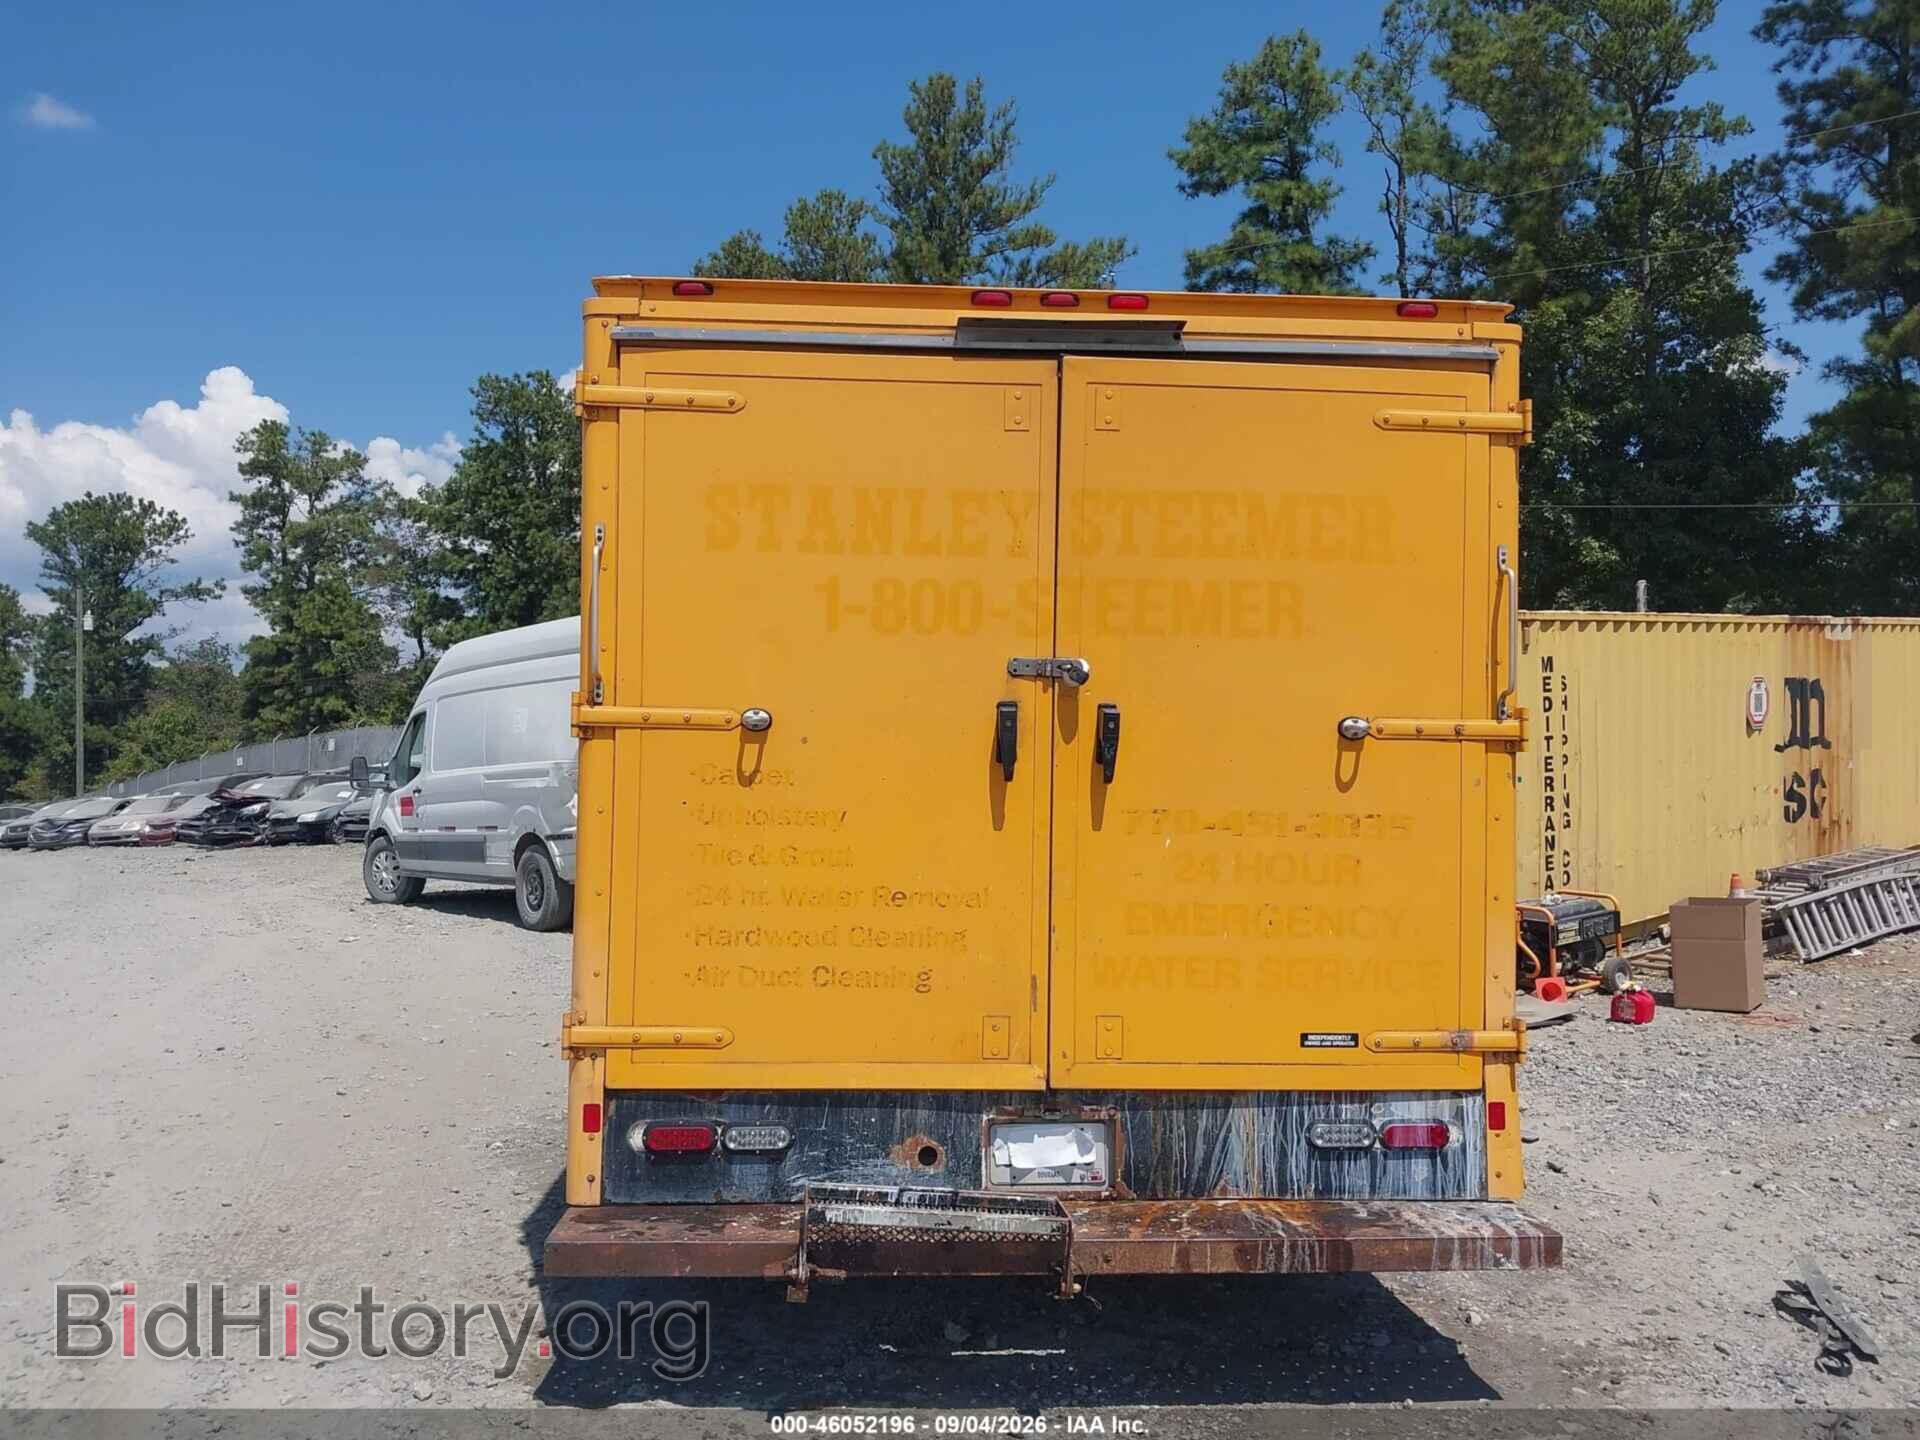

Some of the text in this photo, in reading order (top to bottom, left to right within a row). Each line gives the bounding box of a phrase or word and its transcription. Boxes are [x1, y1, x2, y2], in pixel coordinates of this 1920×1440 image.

[704, 484, 1397, 565] STANLEY STEEMER
[1541, 656, 1555, 892] MEDITERRANEA
[1171, 849, 1364, 888] 24 HOUR
[780, 884, 865, 907] Water
[871, 885, 993, 909] Removal
[693, 924, 968, 952] Hardwood Cleaning
[1124, 900, 1409, 939] EMERGENCY
[691, 965, 934, 994] Air Duct Cleaning
[1089, 954, 1444, 994] WATER SERVICE
